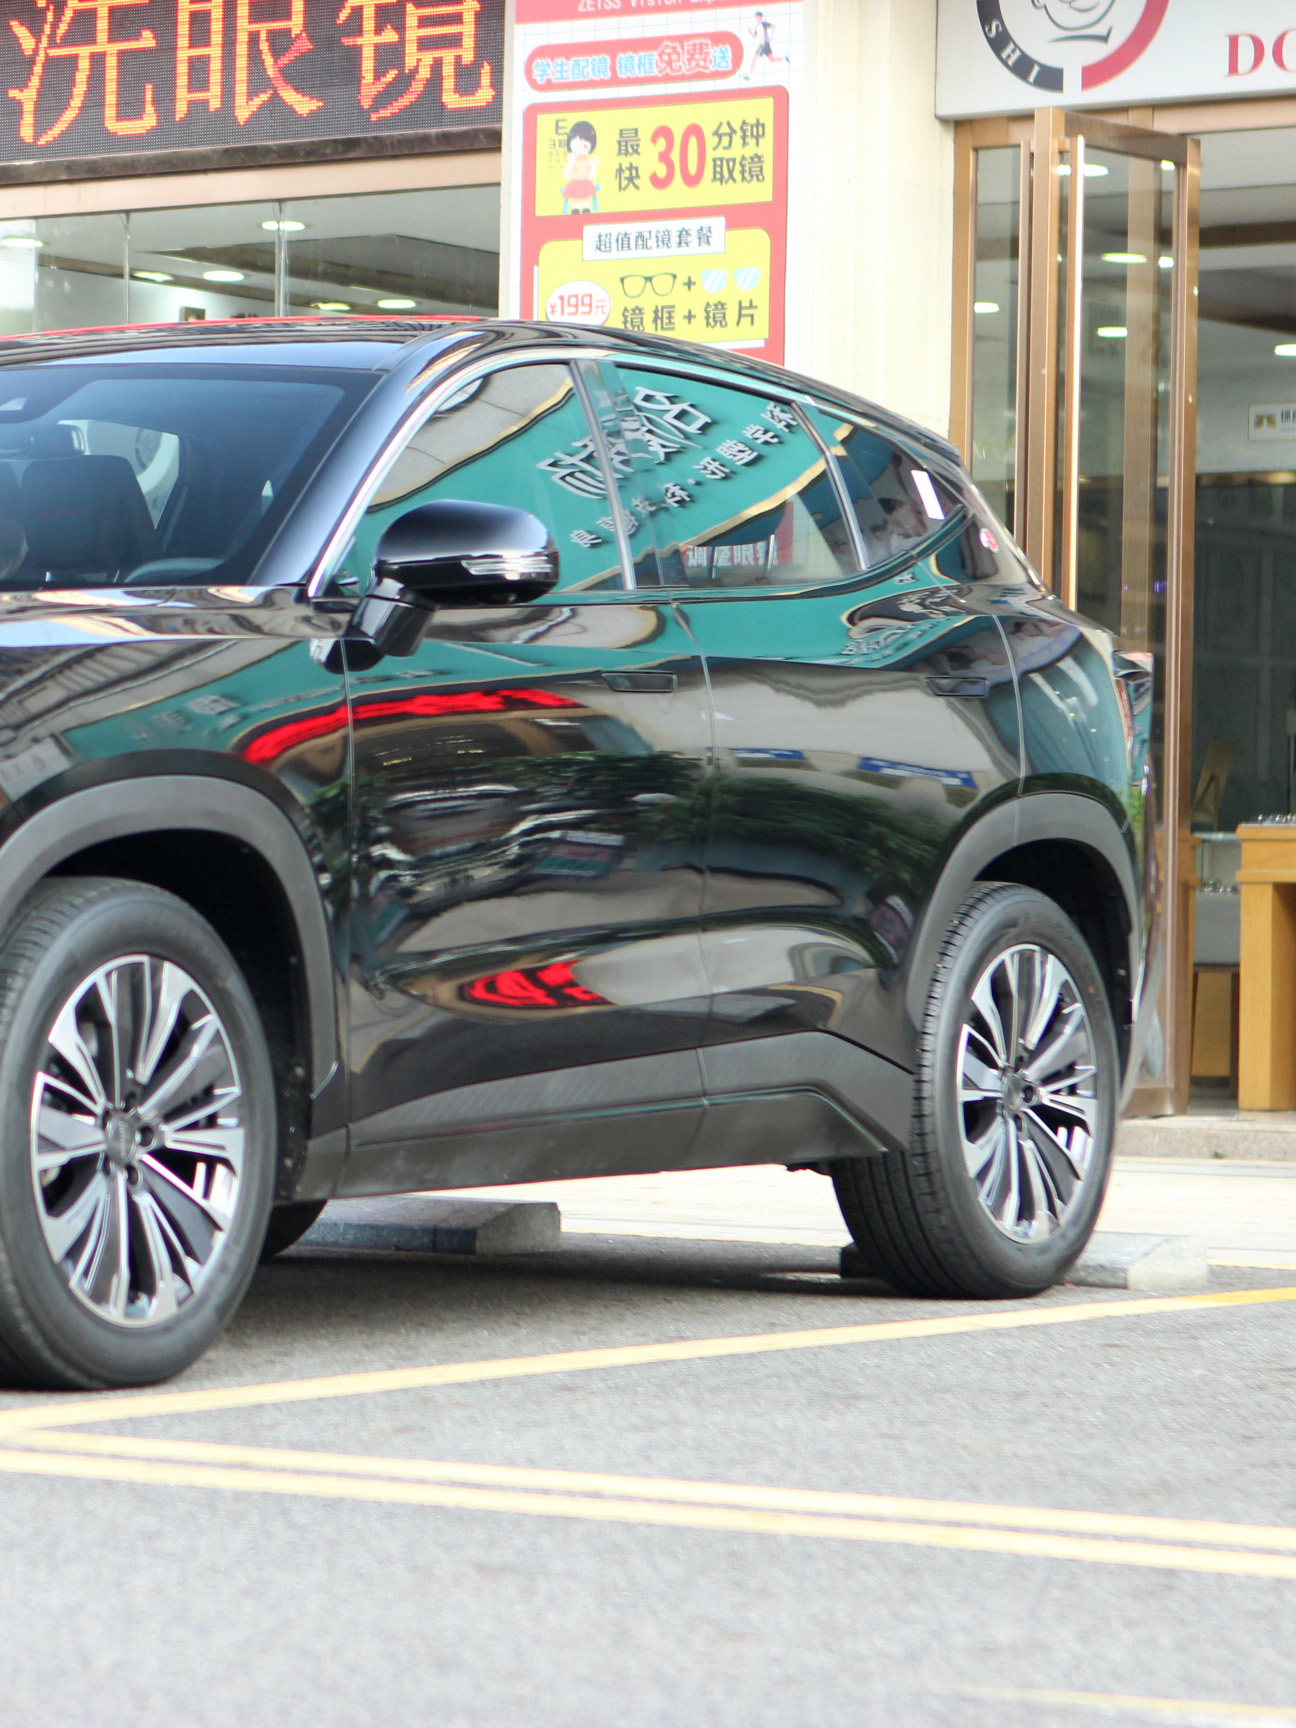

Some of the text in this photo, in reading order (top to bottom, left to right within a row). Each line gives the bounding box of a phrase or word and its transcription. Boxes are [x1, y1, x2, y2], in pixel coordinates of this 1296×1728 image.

[532, 39, 732, 83] 学生配镜 镜框免费送
[711, 118, 766, 151] 分钟
[649, 122, 706, 190] 30
[711, 153, 766, 186] 取镜
[594, 225, 713, 253] 超值配镜套餐
